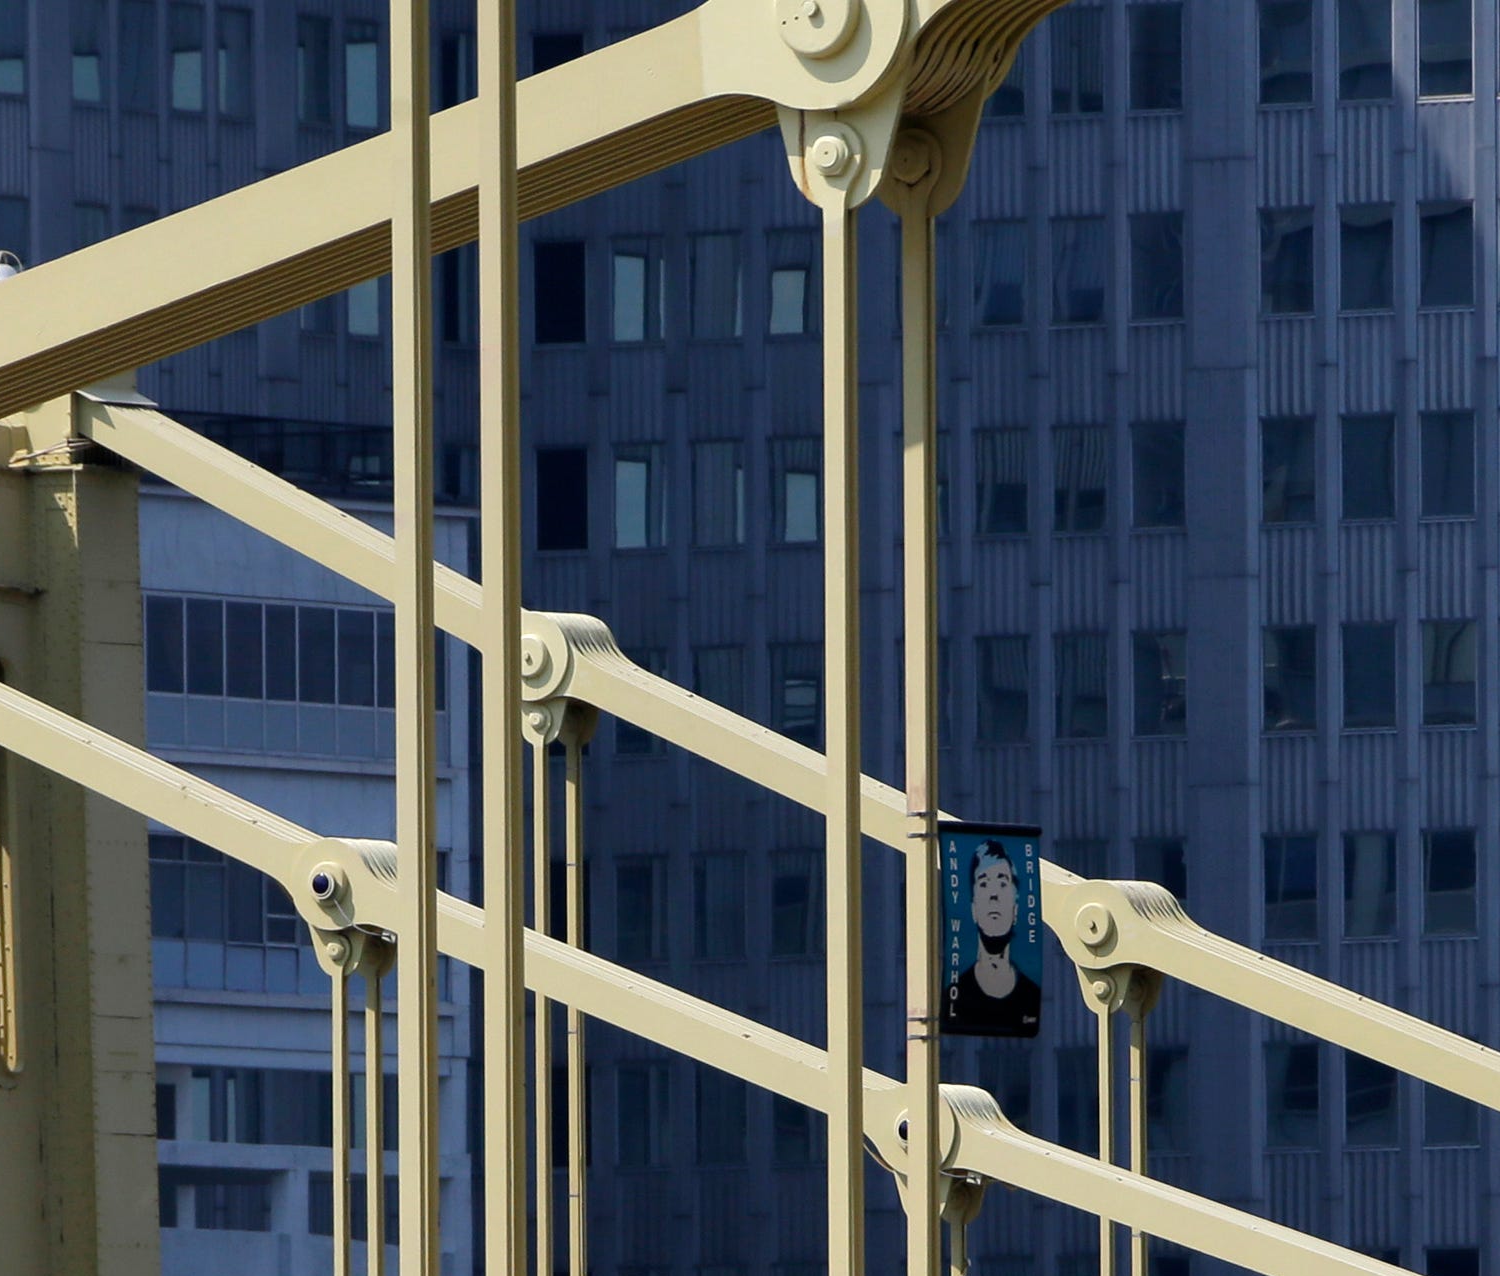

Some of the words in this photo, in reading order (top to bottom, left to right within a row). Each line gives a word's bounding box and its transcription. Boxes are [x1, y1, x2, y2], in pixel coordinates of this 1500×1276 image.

[949, 840, 959, 904] ANDY
[1024, 844, 1037, 943] BRIDGE
[949, 919, 960, 1017] WARHOL
